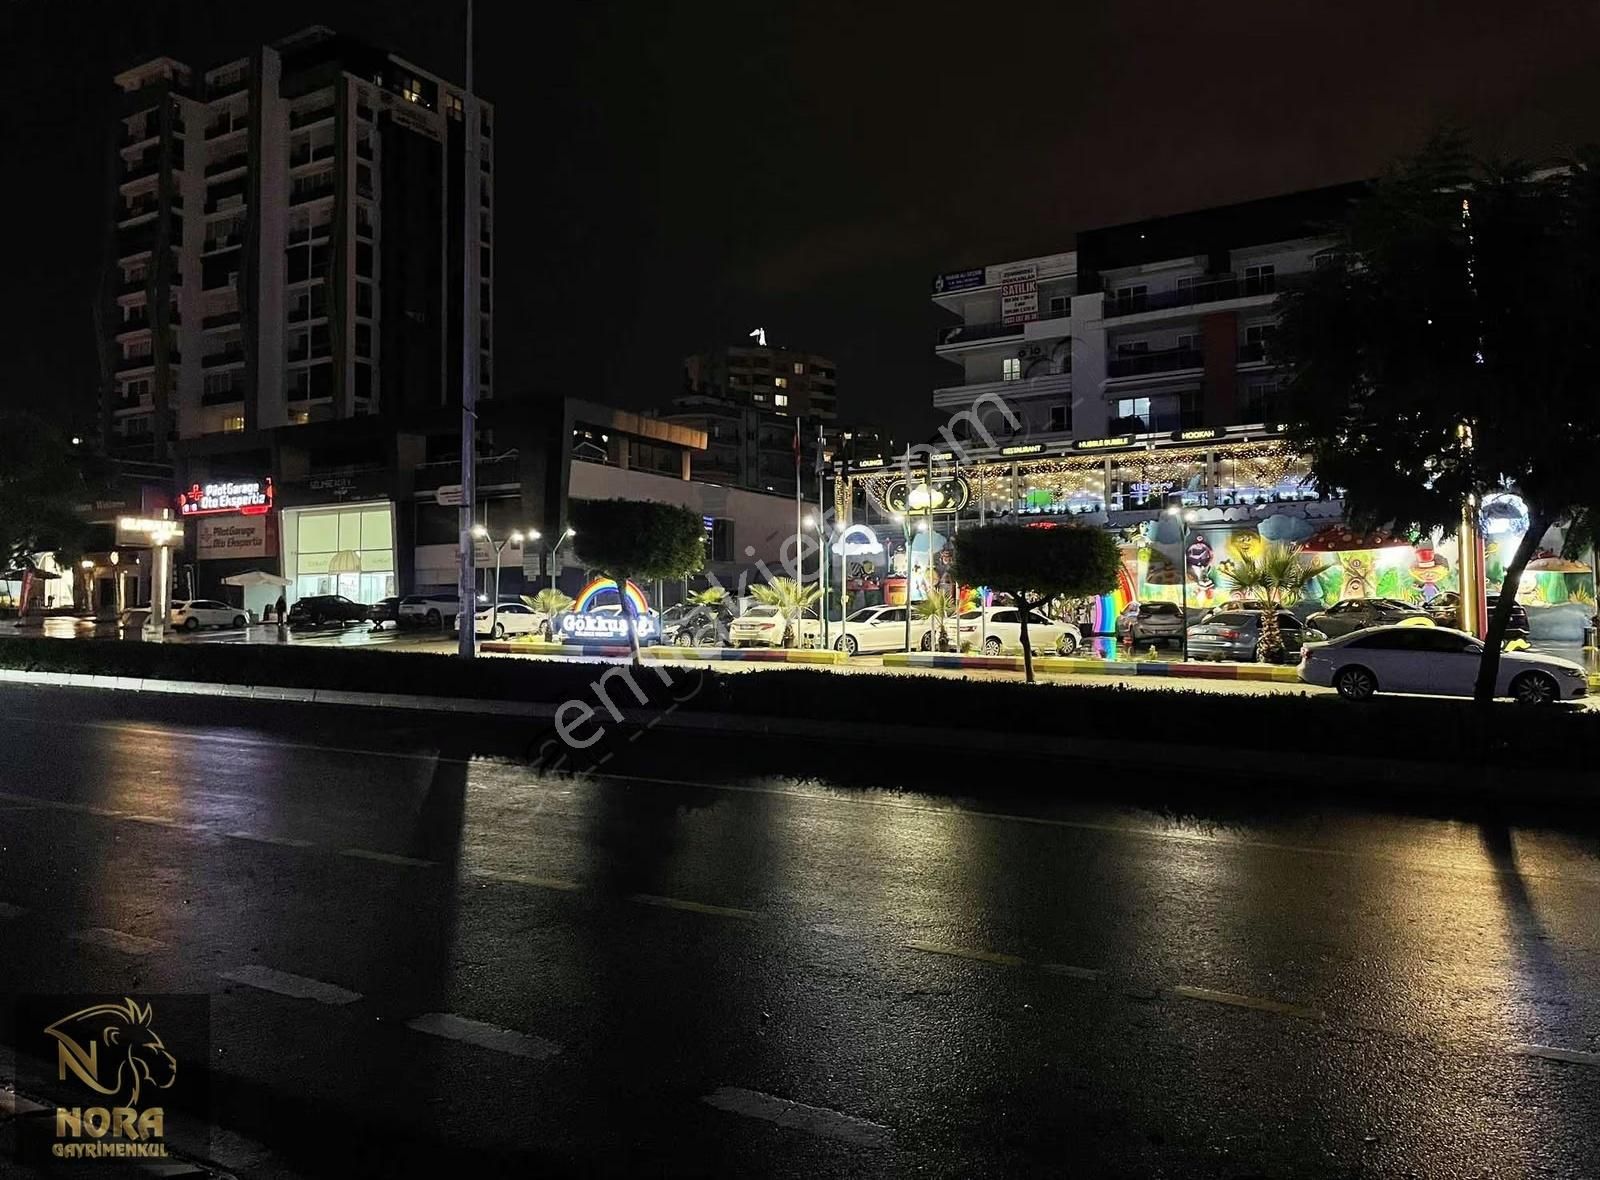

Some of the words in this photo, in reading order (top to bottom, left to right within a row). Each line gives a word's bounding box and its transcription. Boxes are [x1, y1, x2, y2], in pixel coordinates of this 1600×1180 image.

[1002, 280, 1036, 296] SATILIK
[1182, 430, 1214, 439] HOOKAH
[1104, 437, 1128, 446] BUBBLE
[1003, 445, 1042, 454] RESTAURANT
[859, 458, 884, 467] LOUNGE
[200, 496, 218, 508] Oto
